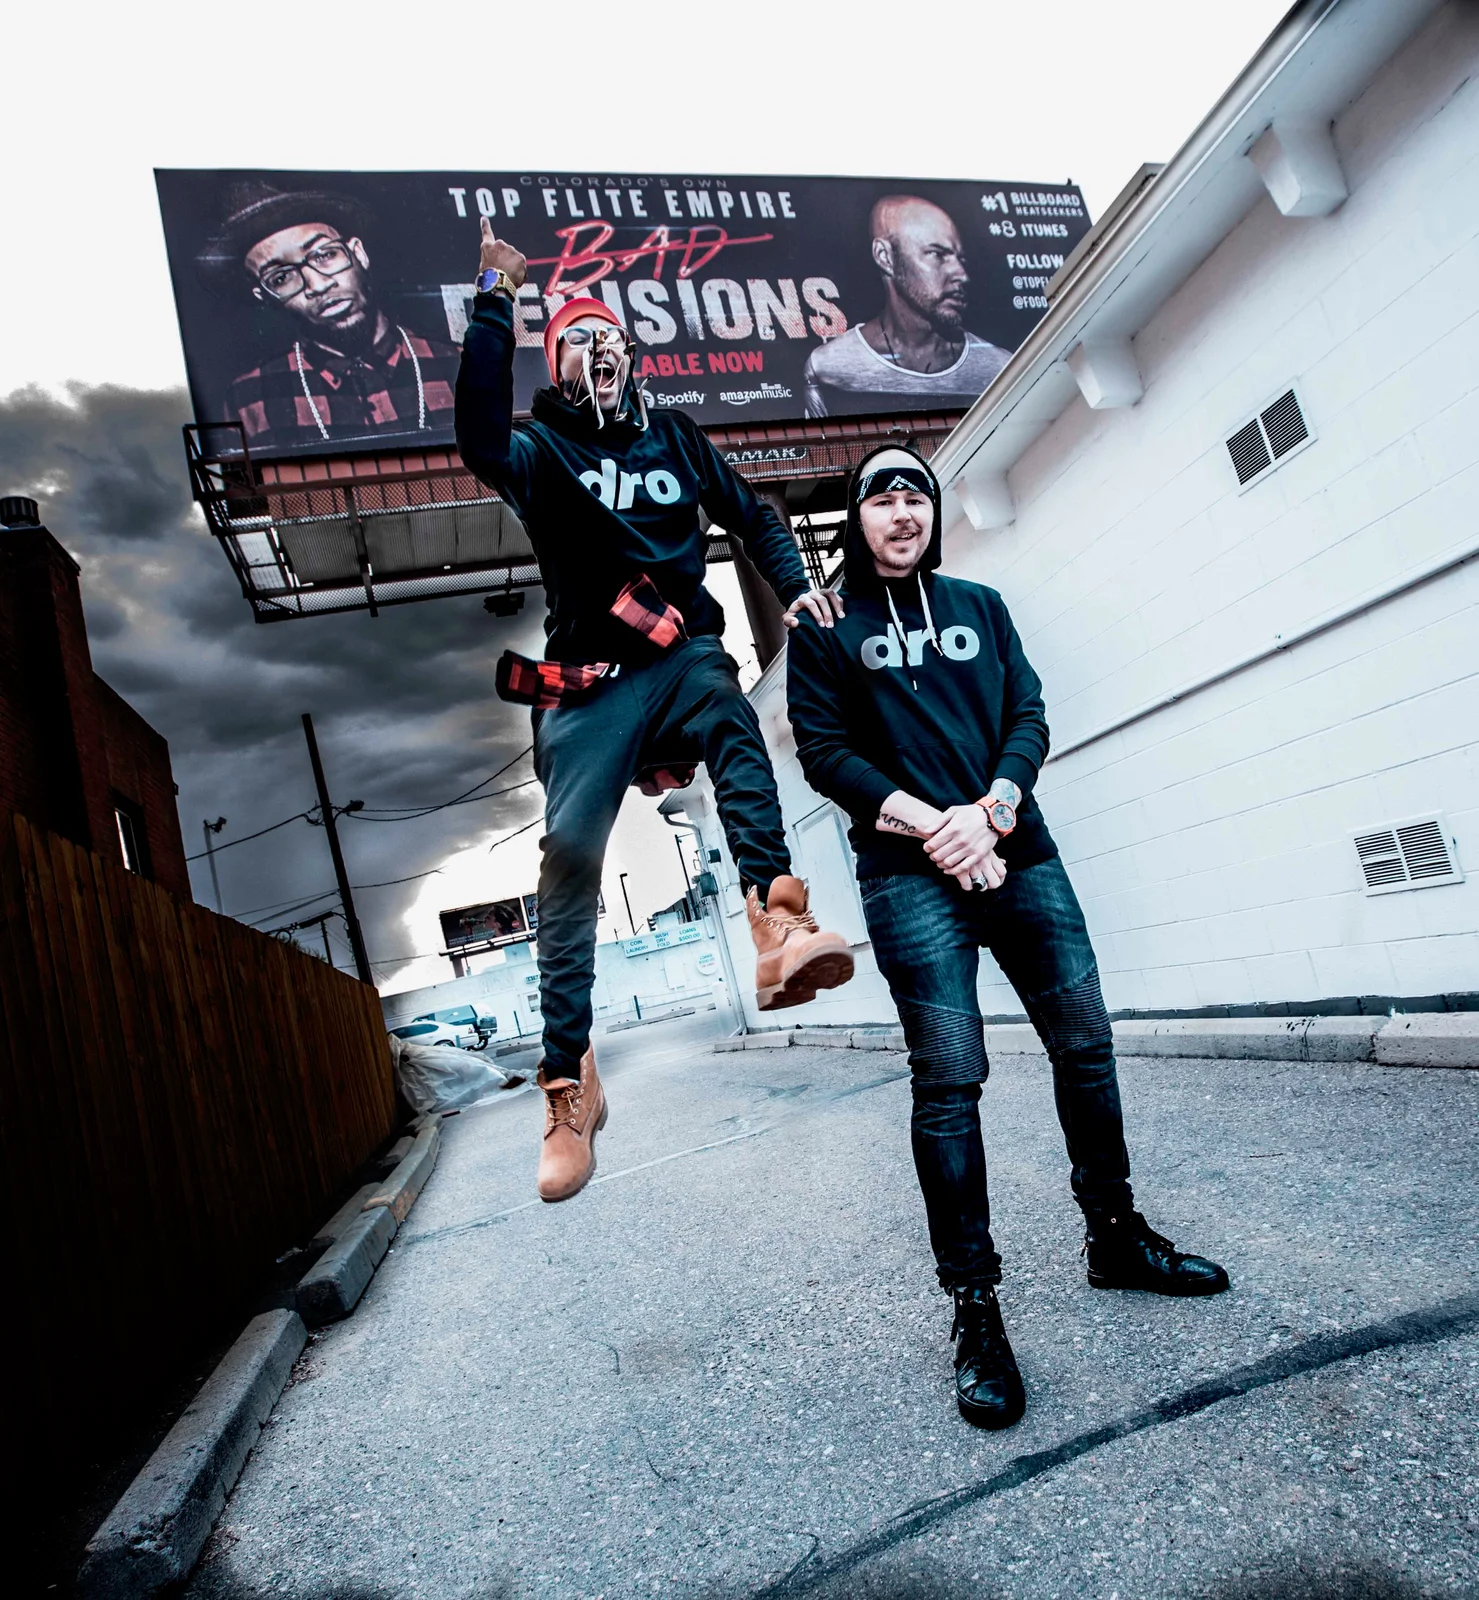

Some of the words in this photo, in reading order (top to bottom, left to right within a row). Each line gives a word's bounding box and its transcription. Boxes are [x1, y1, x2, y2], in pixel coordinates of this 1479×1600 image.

[520, 175, 670, 188] COLORADO'S
[682, 178, 728, 189] OWN
[448, 187, 521, 218] TOP
[542, 187, 648, 218] FLITE
[664, 188, 797, 219] EMPIRE
[980, 191, 1009, 215] #1
[1009, 191, 1081, 207] BILLBOARD
[1014, 206, 1084, 218] HEATSEEKERS
[988, 219, 1017, 238] #8
[1020, 222, 1069, 238] ITUNES
[527, 219, 774, 297] BAD
[1006, 253, 1064, 270] FOLLOW
[708, 351, 764, 374] NOW
[656, 390, 705, 407] Spotify
[578, 458, 681, 511] dro
[860, 621, 981, 670] dro
[654, 931, 669, 939] WASH
[679, 927, 697, 935] LOANS
[626, 944, 649, 954] LAUNDRY
[630, 939, 643, 947] COIN
